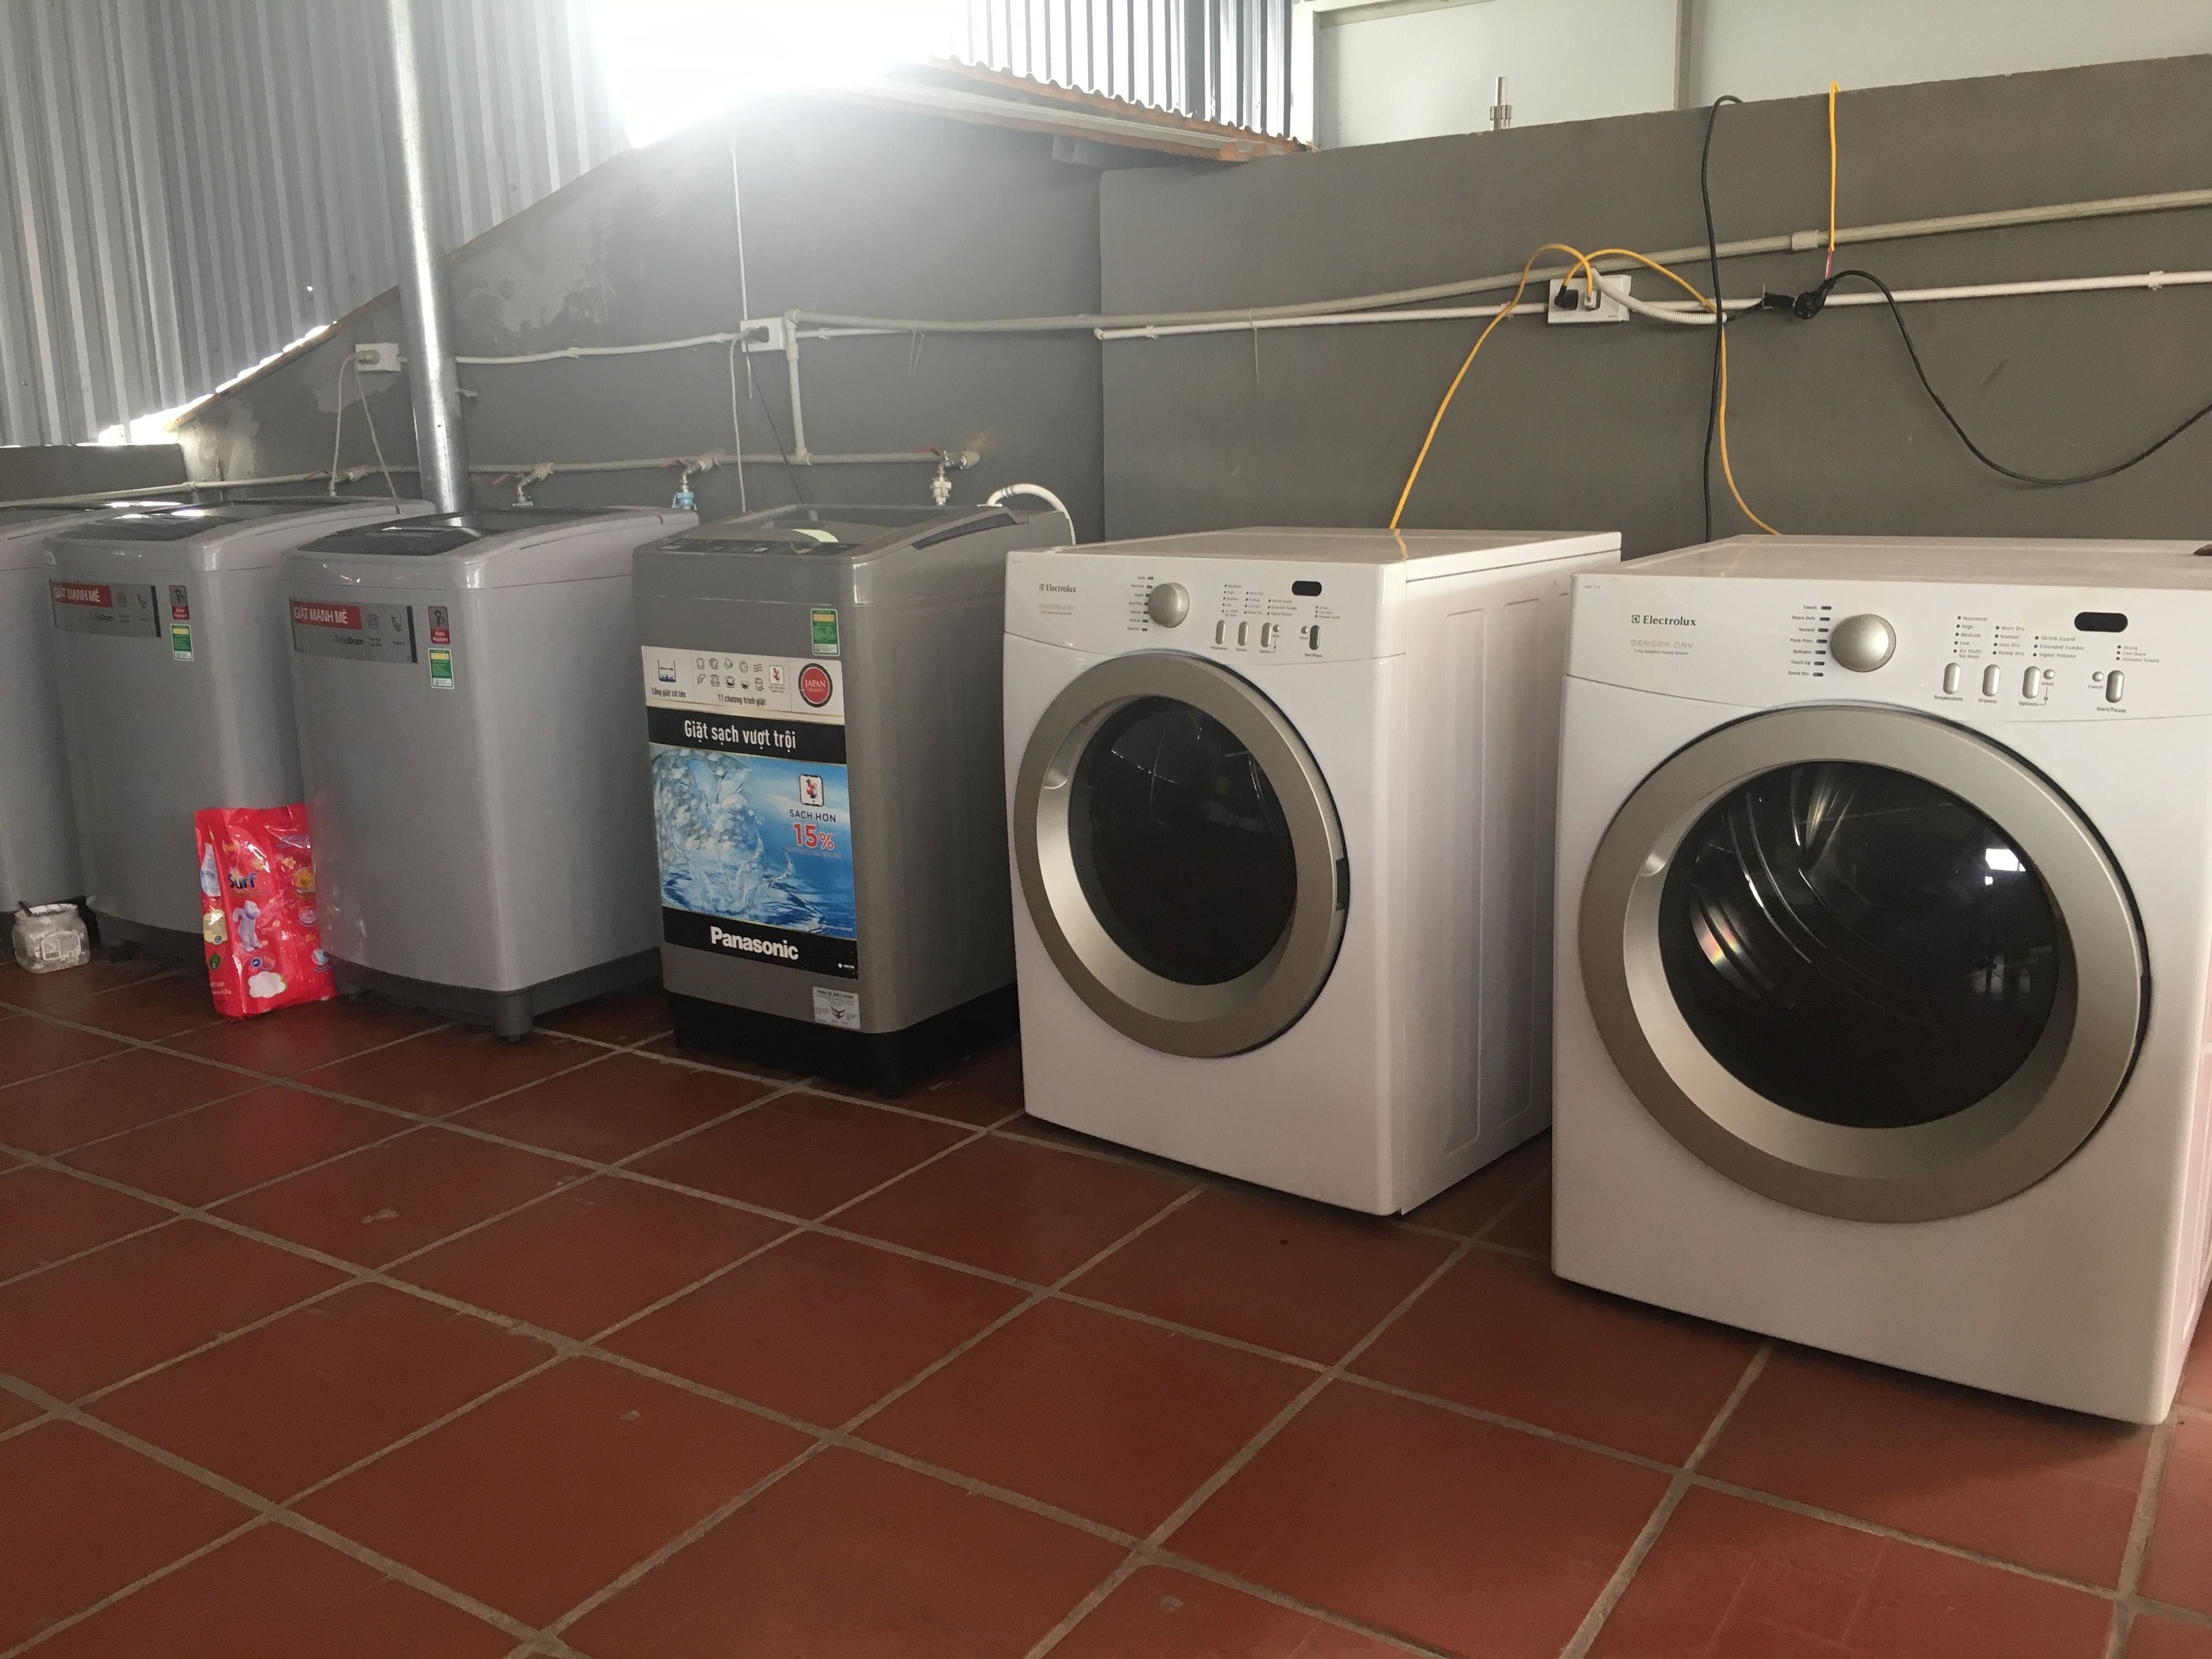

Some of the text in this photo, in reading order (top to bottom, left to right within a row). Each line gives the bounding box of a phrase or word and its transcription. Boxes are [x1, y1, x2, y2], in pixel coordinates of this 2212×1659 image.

[1046, 584, 1076, 592] Electrolux
[1643, 615, 1696, 626] Electrolux
[805, 679, 826, 688] JAPAN
[684, 721, 796, 753] Giặt sạch vượt trội
[793, 823, 835, 851] 15%
[710, 926, 799, 960] Panasonic
